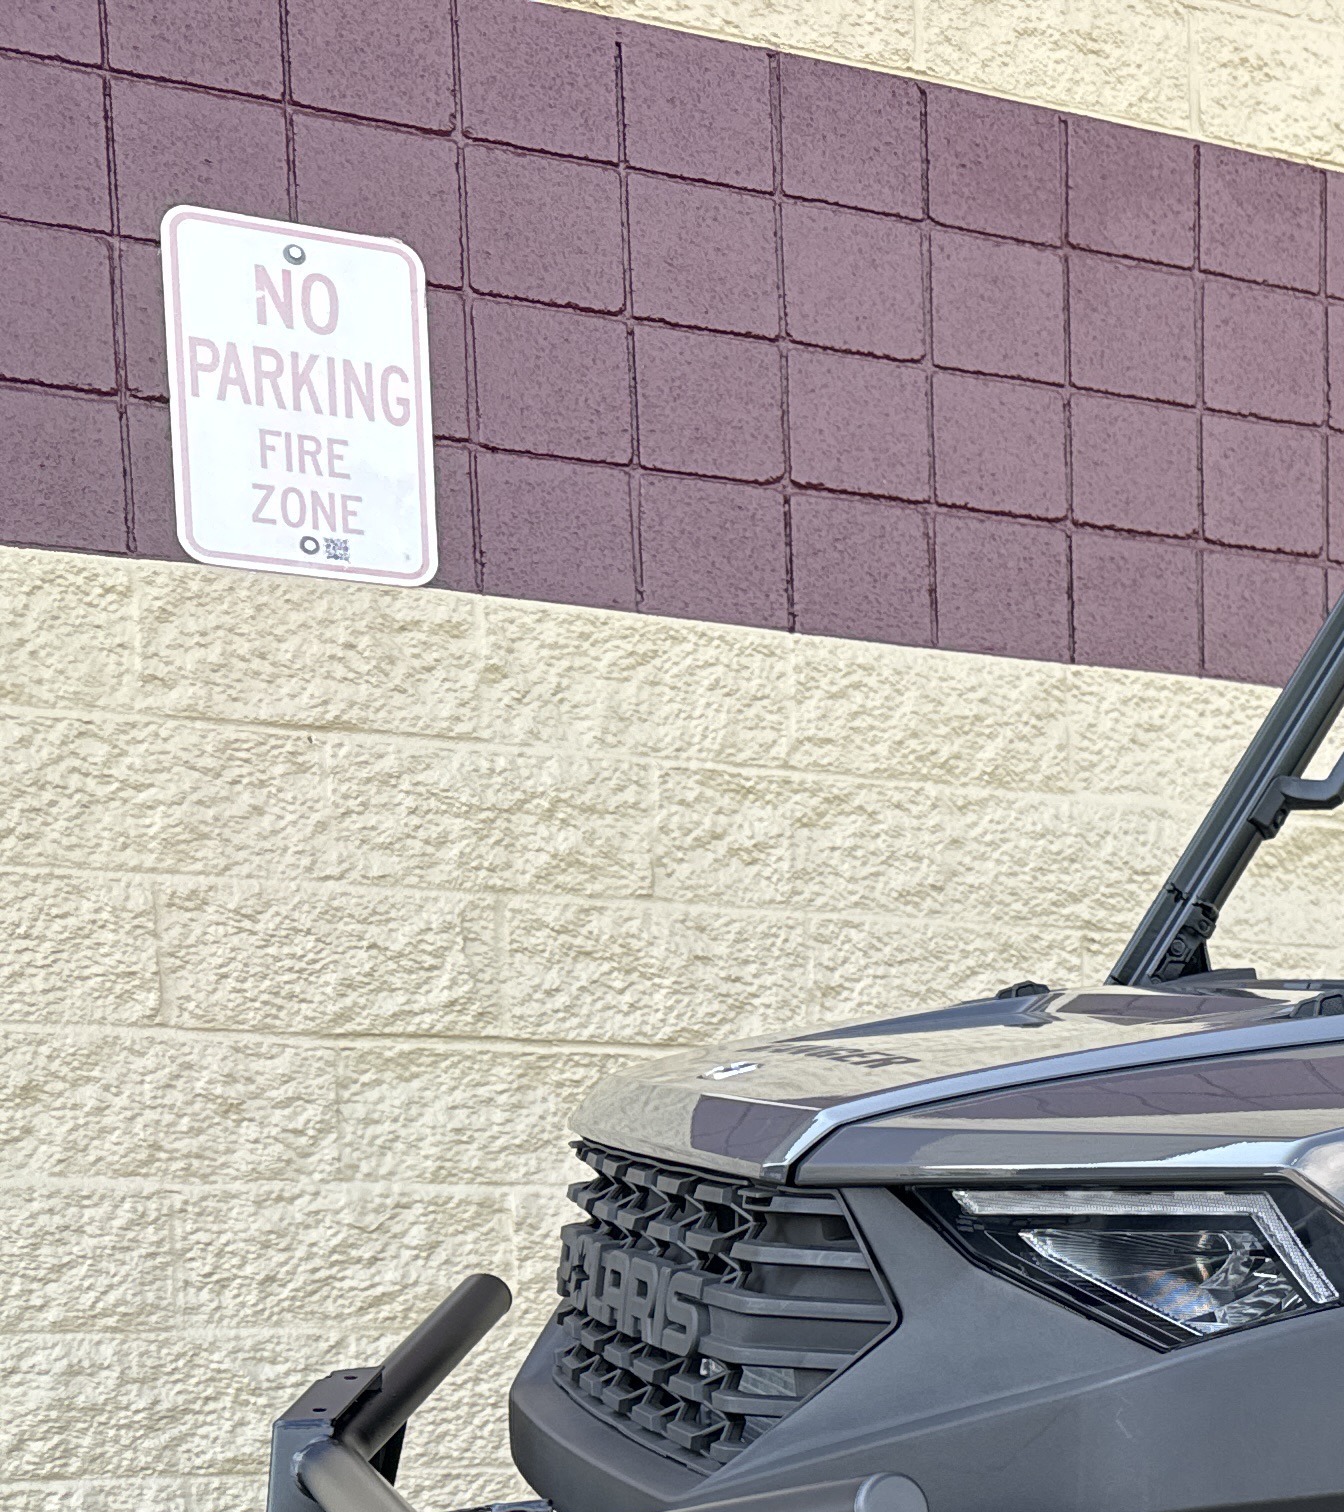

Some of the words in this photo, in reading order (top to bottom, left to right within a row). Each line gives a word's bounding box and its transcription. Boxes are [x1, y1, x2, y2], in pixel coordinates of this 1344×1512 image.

[254, 264, 339, 336] NO
[188, 336, 411, 427] PARKING
[259, 428, 351, 480] FIRE
[251, 483, 365, 535] ZONE
[557, 1223, 704, 1357] POLARIS
